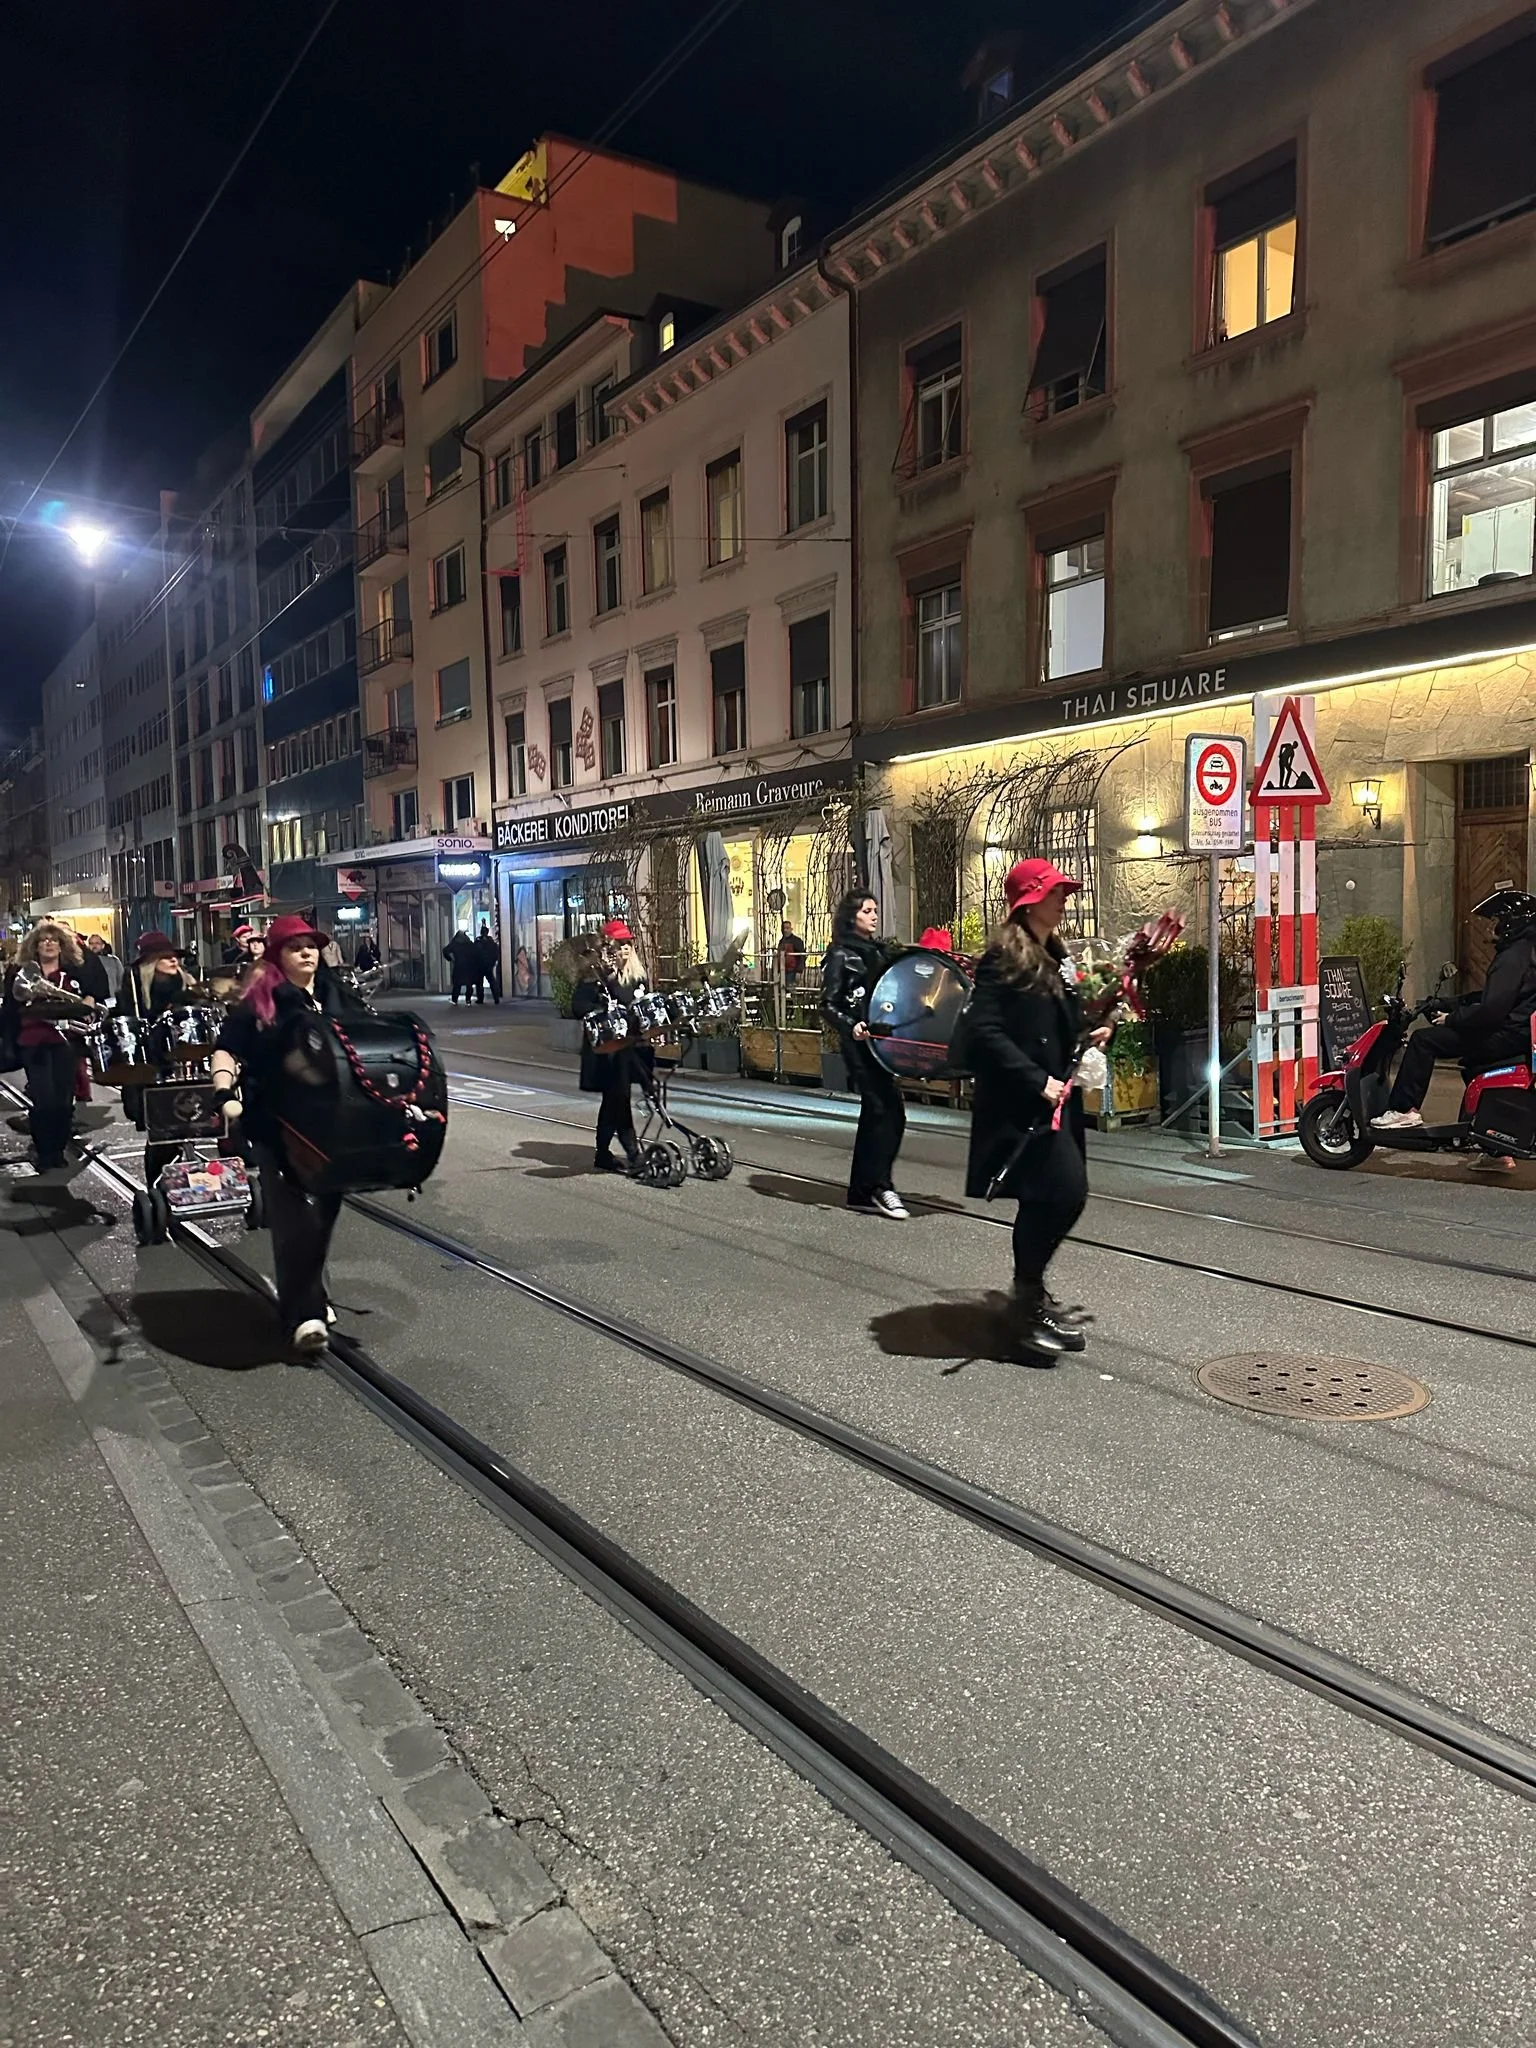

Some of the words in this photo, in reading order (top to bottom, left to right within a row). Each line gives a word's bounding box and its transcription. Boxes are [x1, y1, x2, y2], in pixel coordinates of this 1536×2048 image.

[1062, 692, 1115, 720] THAI
[1126, 668, 1227, 707] SQUARE
[695, 789, 752, 815] Reimann
[756, 779, 824, 805] Graveure
[1193, 808, 1238, 818] ausgenommen
[1209, 817, 1222, 827] BUS
[497, 819, 550, 848] BÄCKEREI
[554, 804, 629, 841] KONDITOREI
[1323, 968, 1345, 982] THAI
[1323, 981, 1353, 999] SQUARE
